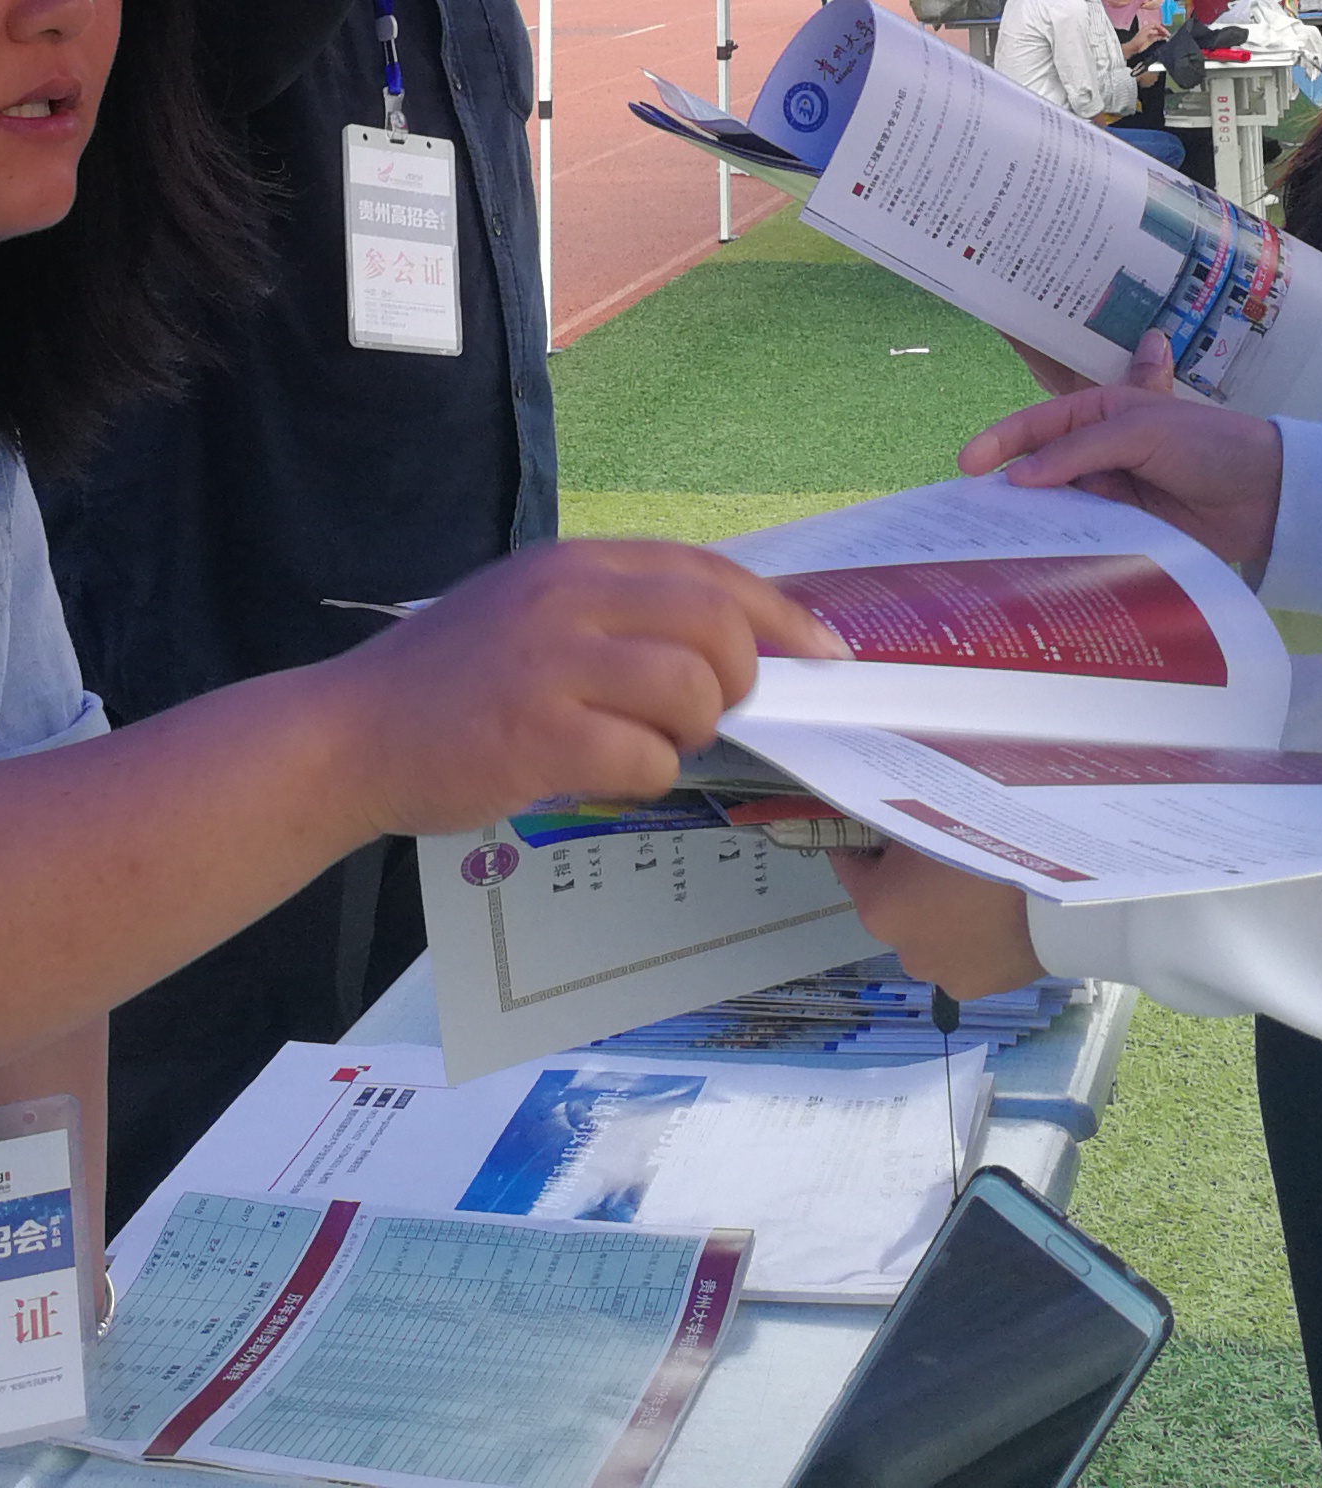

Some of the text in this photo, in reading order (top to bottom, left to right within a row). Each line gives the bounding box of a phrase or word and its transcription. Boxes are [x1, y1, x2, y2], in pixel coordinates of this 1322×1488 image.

[358, 199, 440, 231] 贵州高招会
[364, 247, 446, 287] 参会证
